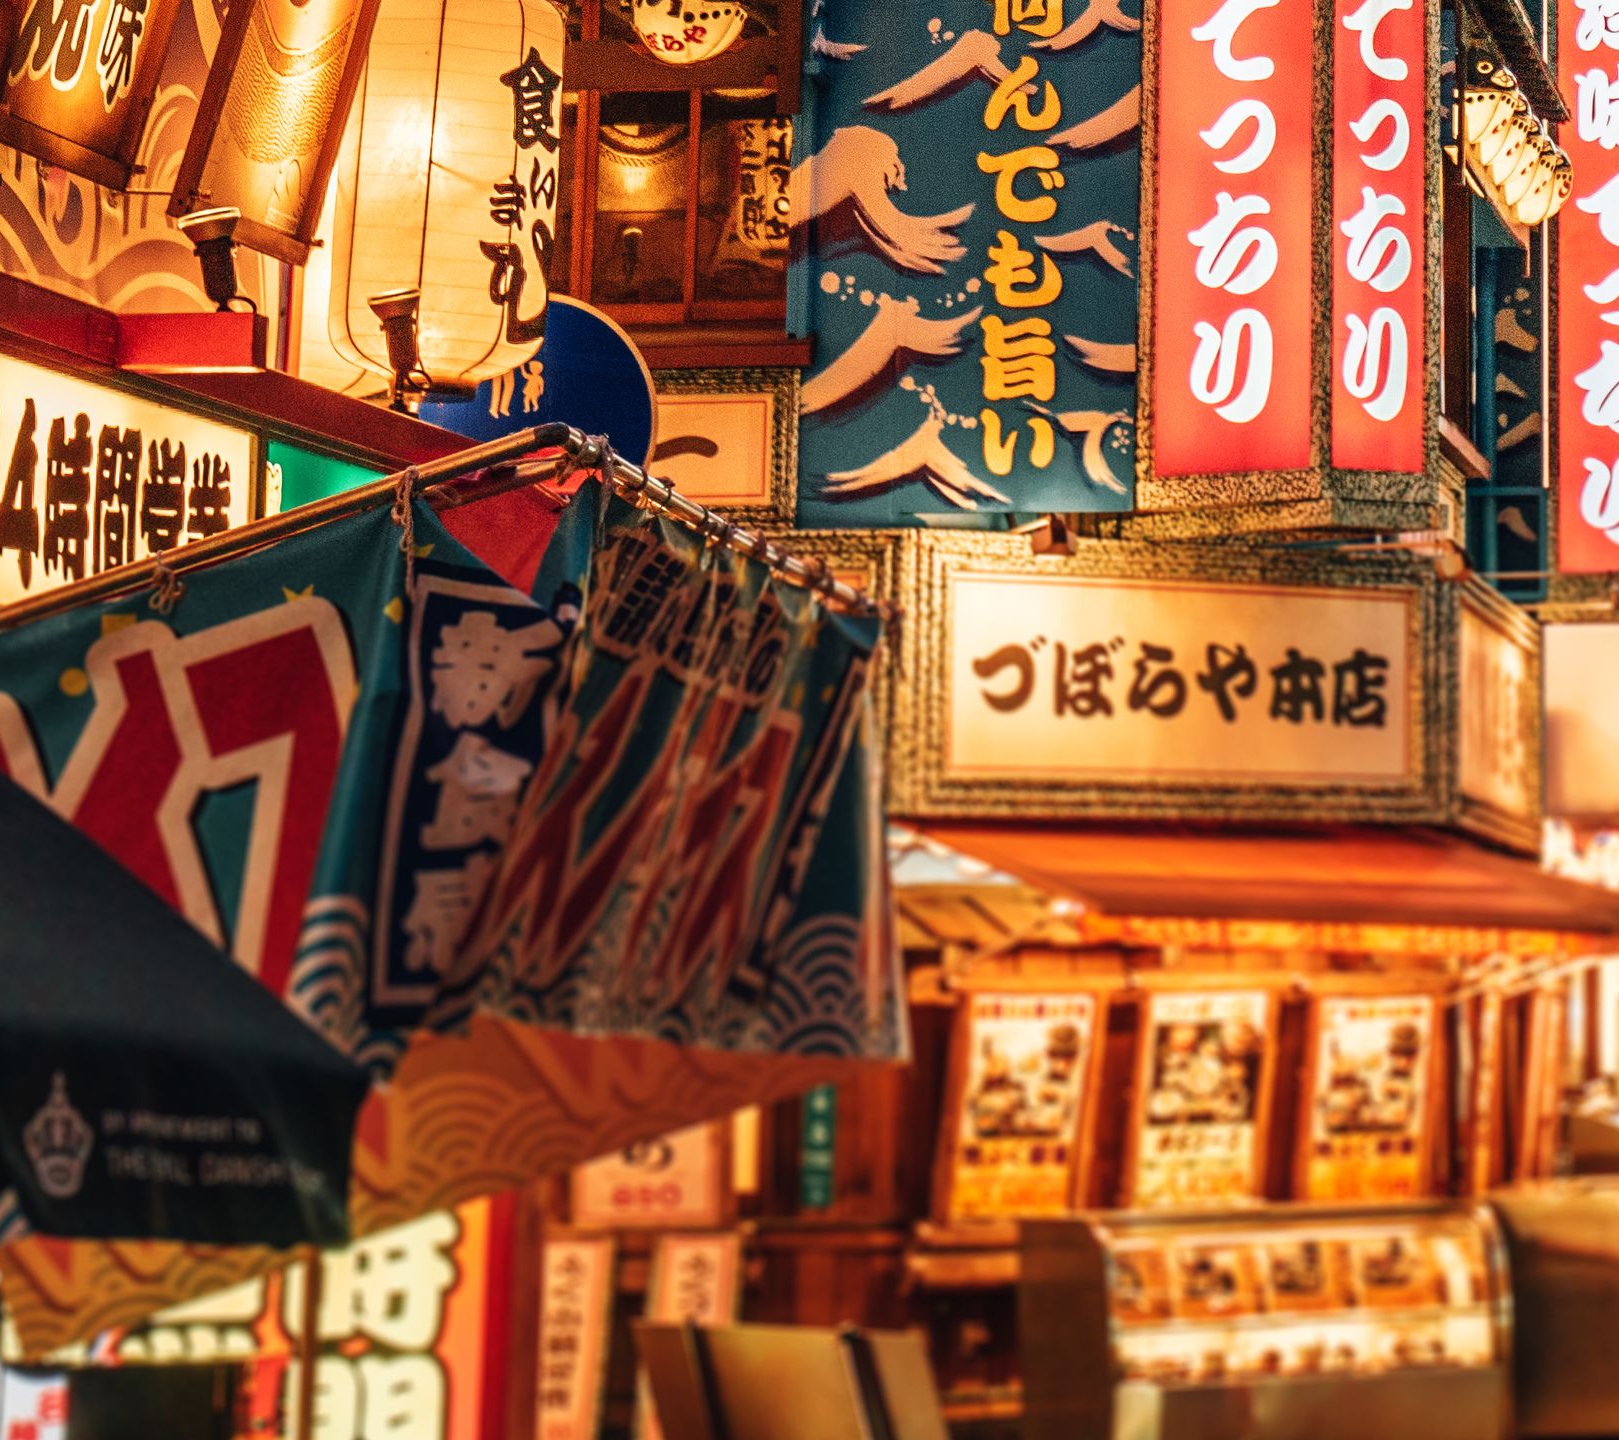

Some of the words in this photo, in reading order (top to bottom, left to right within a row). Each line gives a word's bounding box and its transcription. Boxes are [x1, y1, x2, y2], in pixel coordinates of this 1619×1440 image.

[974, 636, 1388, 731] づぼらや本店
